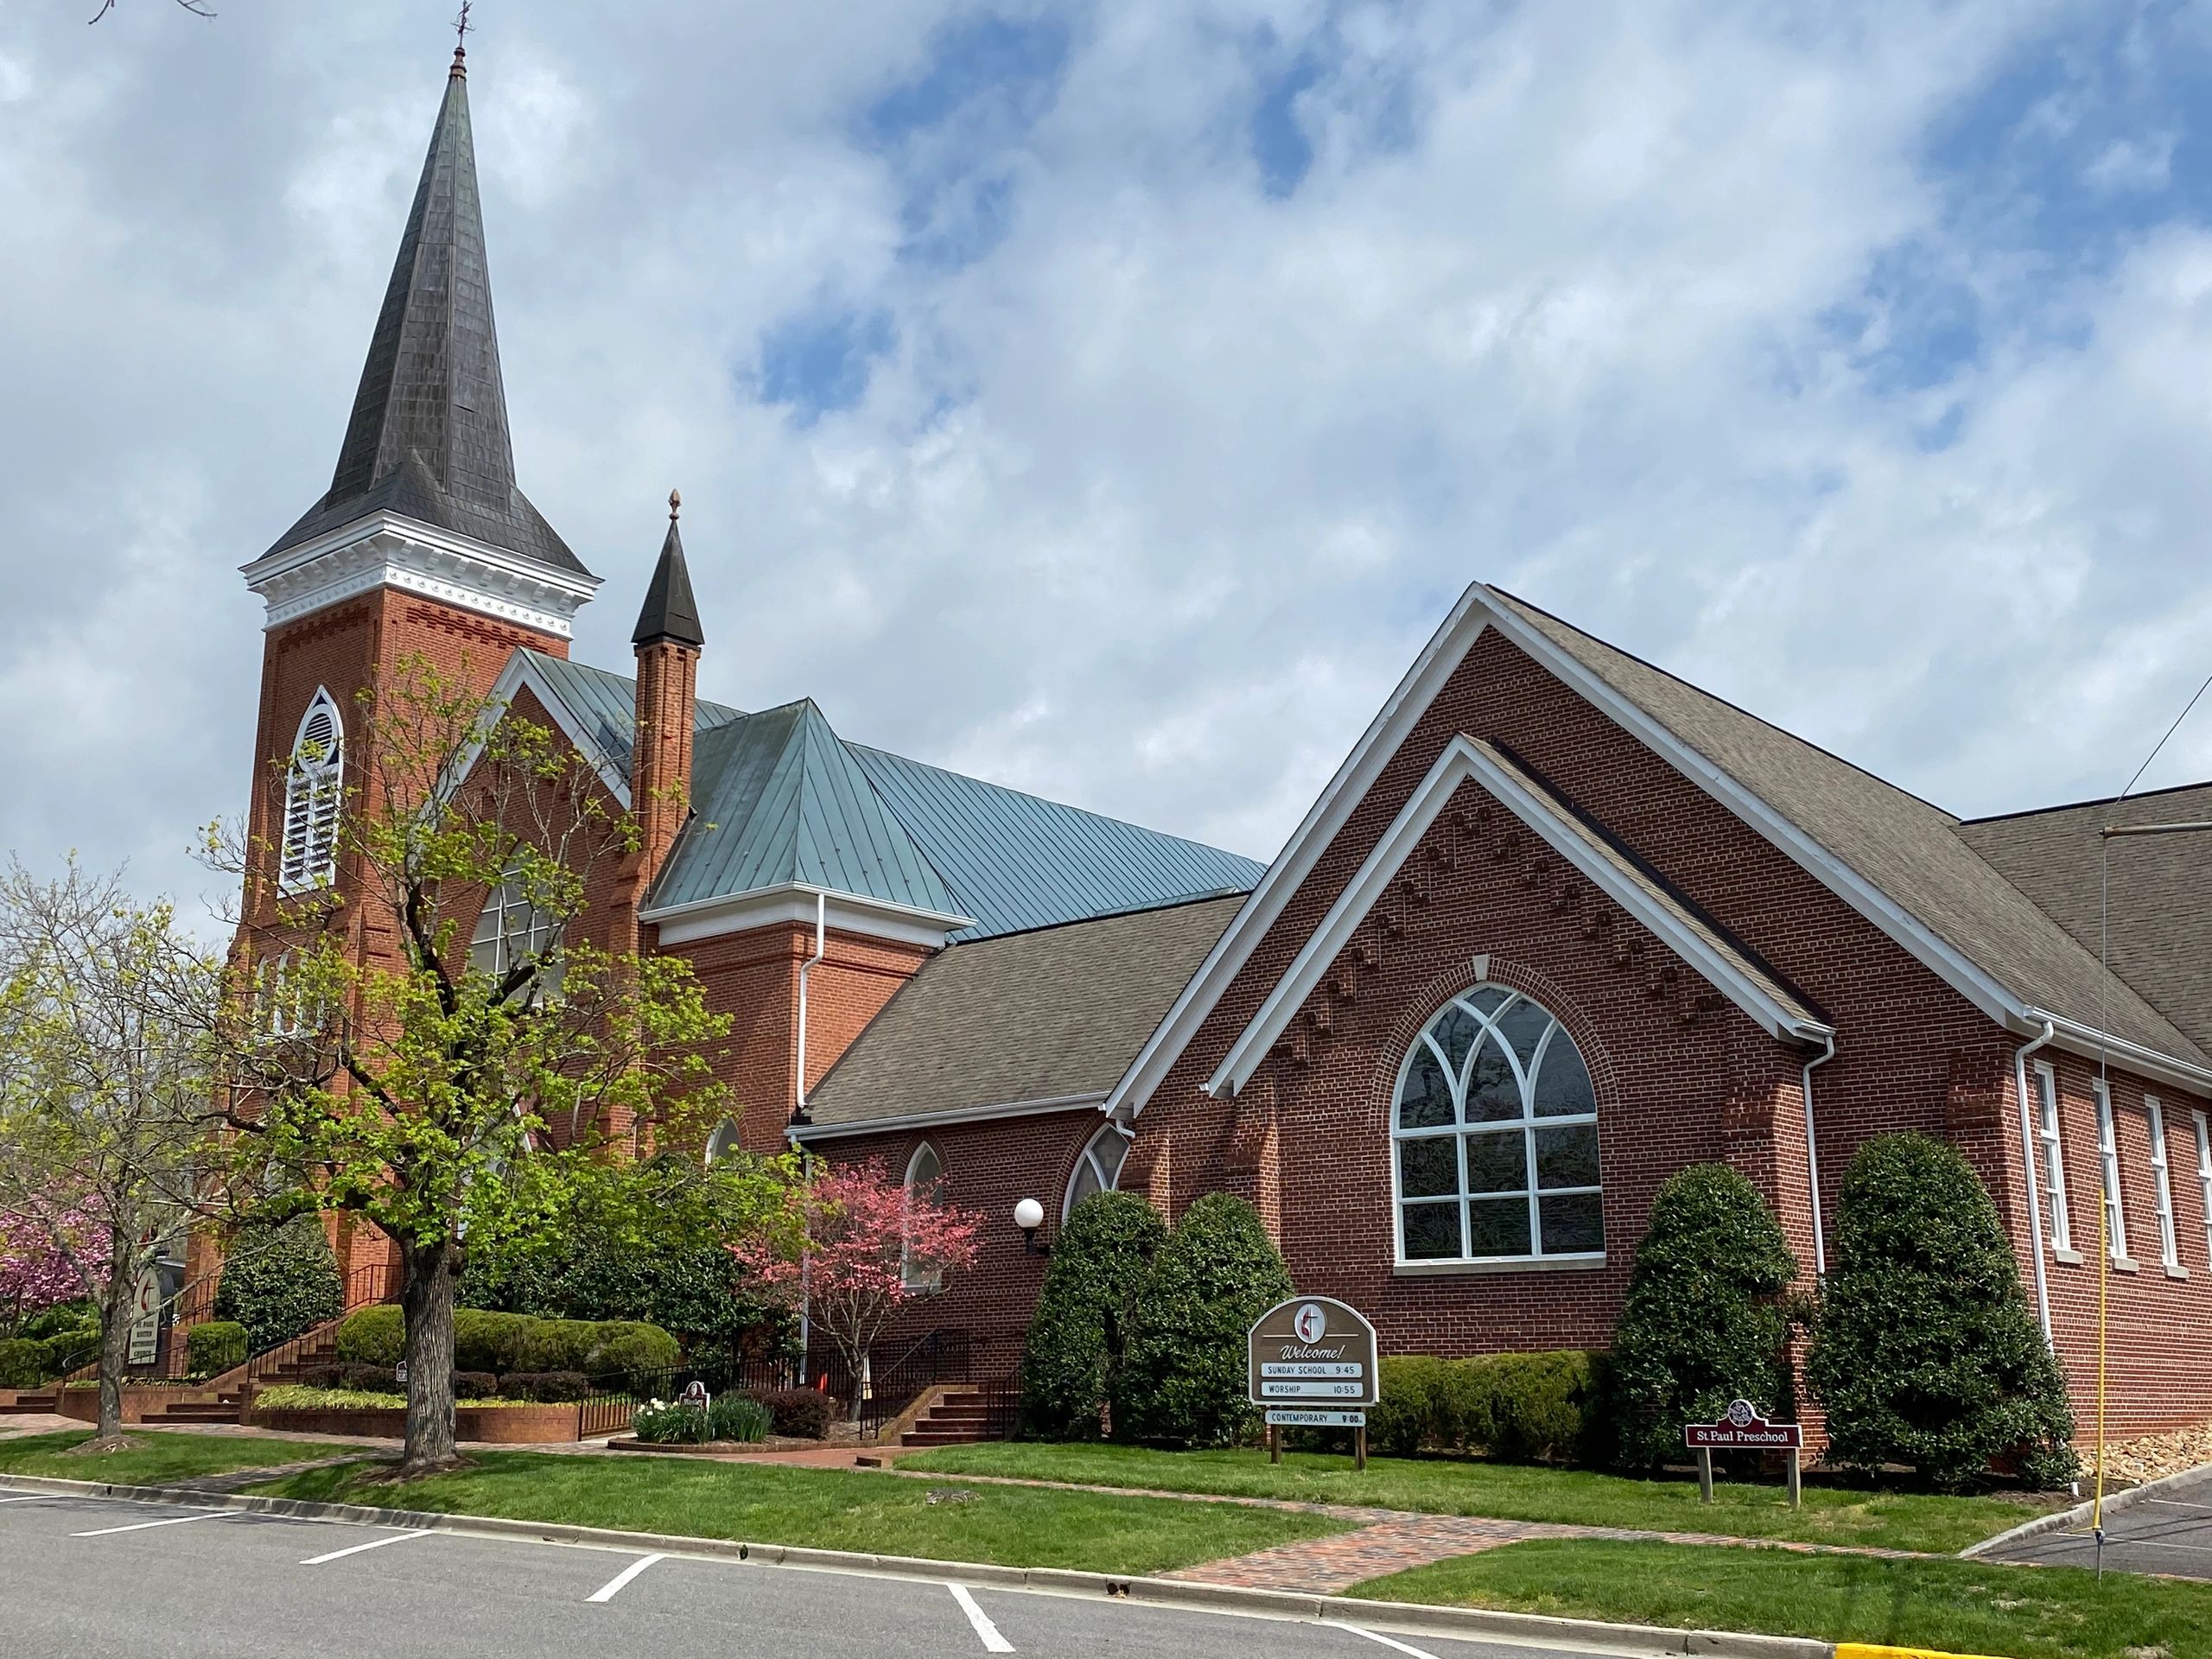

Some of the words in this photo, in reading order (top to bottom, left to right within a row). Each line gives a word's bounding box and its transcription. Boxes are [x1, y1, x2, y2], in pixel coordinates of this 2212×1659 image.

[1280, 1344, 1345, 1360] Welcome!
[1268, 1366, 1295, 1375] SUNDAY
[1298, 1366, 1326, 1375] SCHOOL
[1268, 1385, 1301, 1394] WORSHIP
[1333, 1385, 1355, 1394] 10:55
[1271, 1413, 1328, 1423] CONTEMPORARY
[1710, 1430, 1733, 1441] Paul
[1736, 1431, 1789, 1442] Preschool
